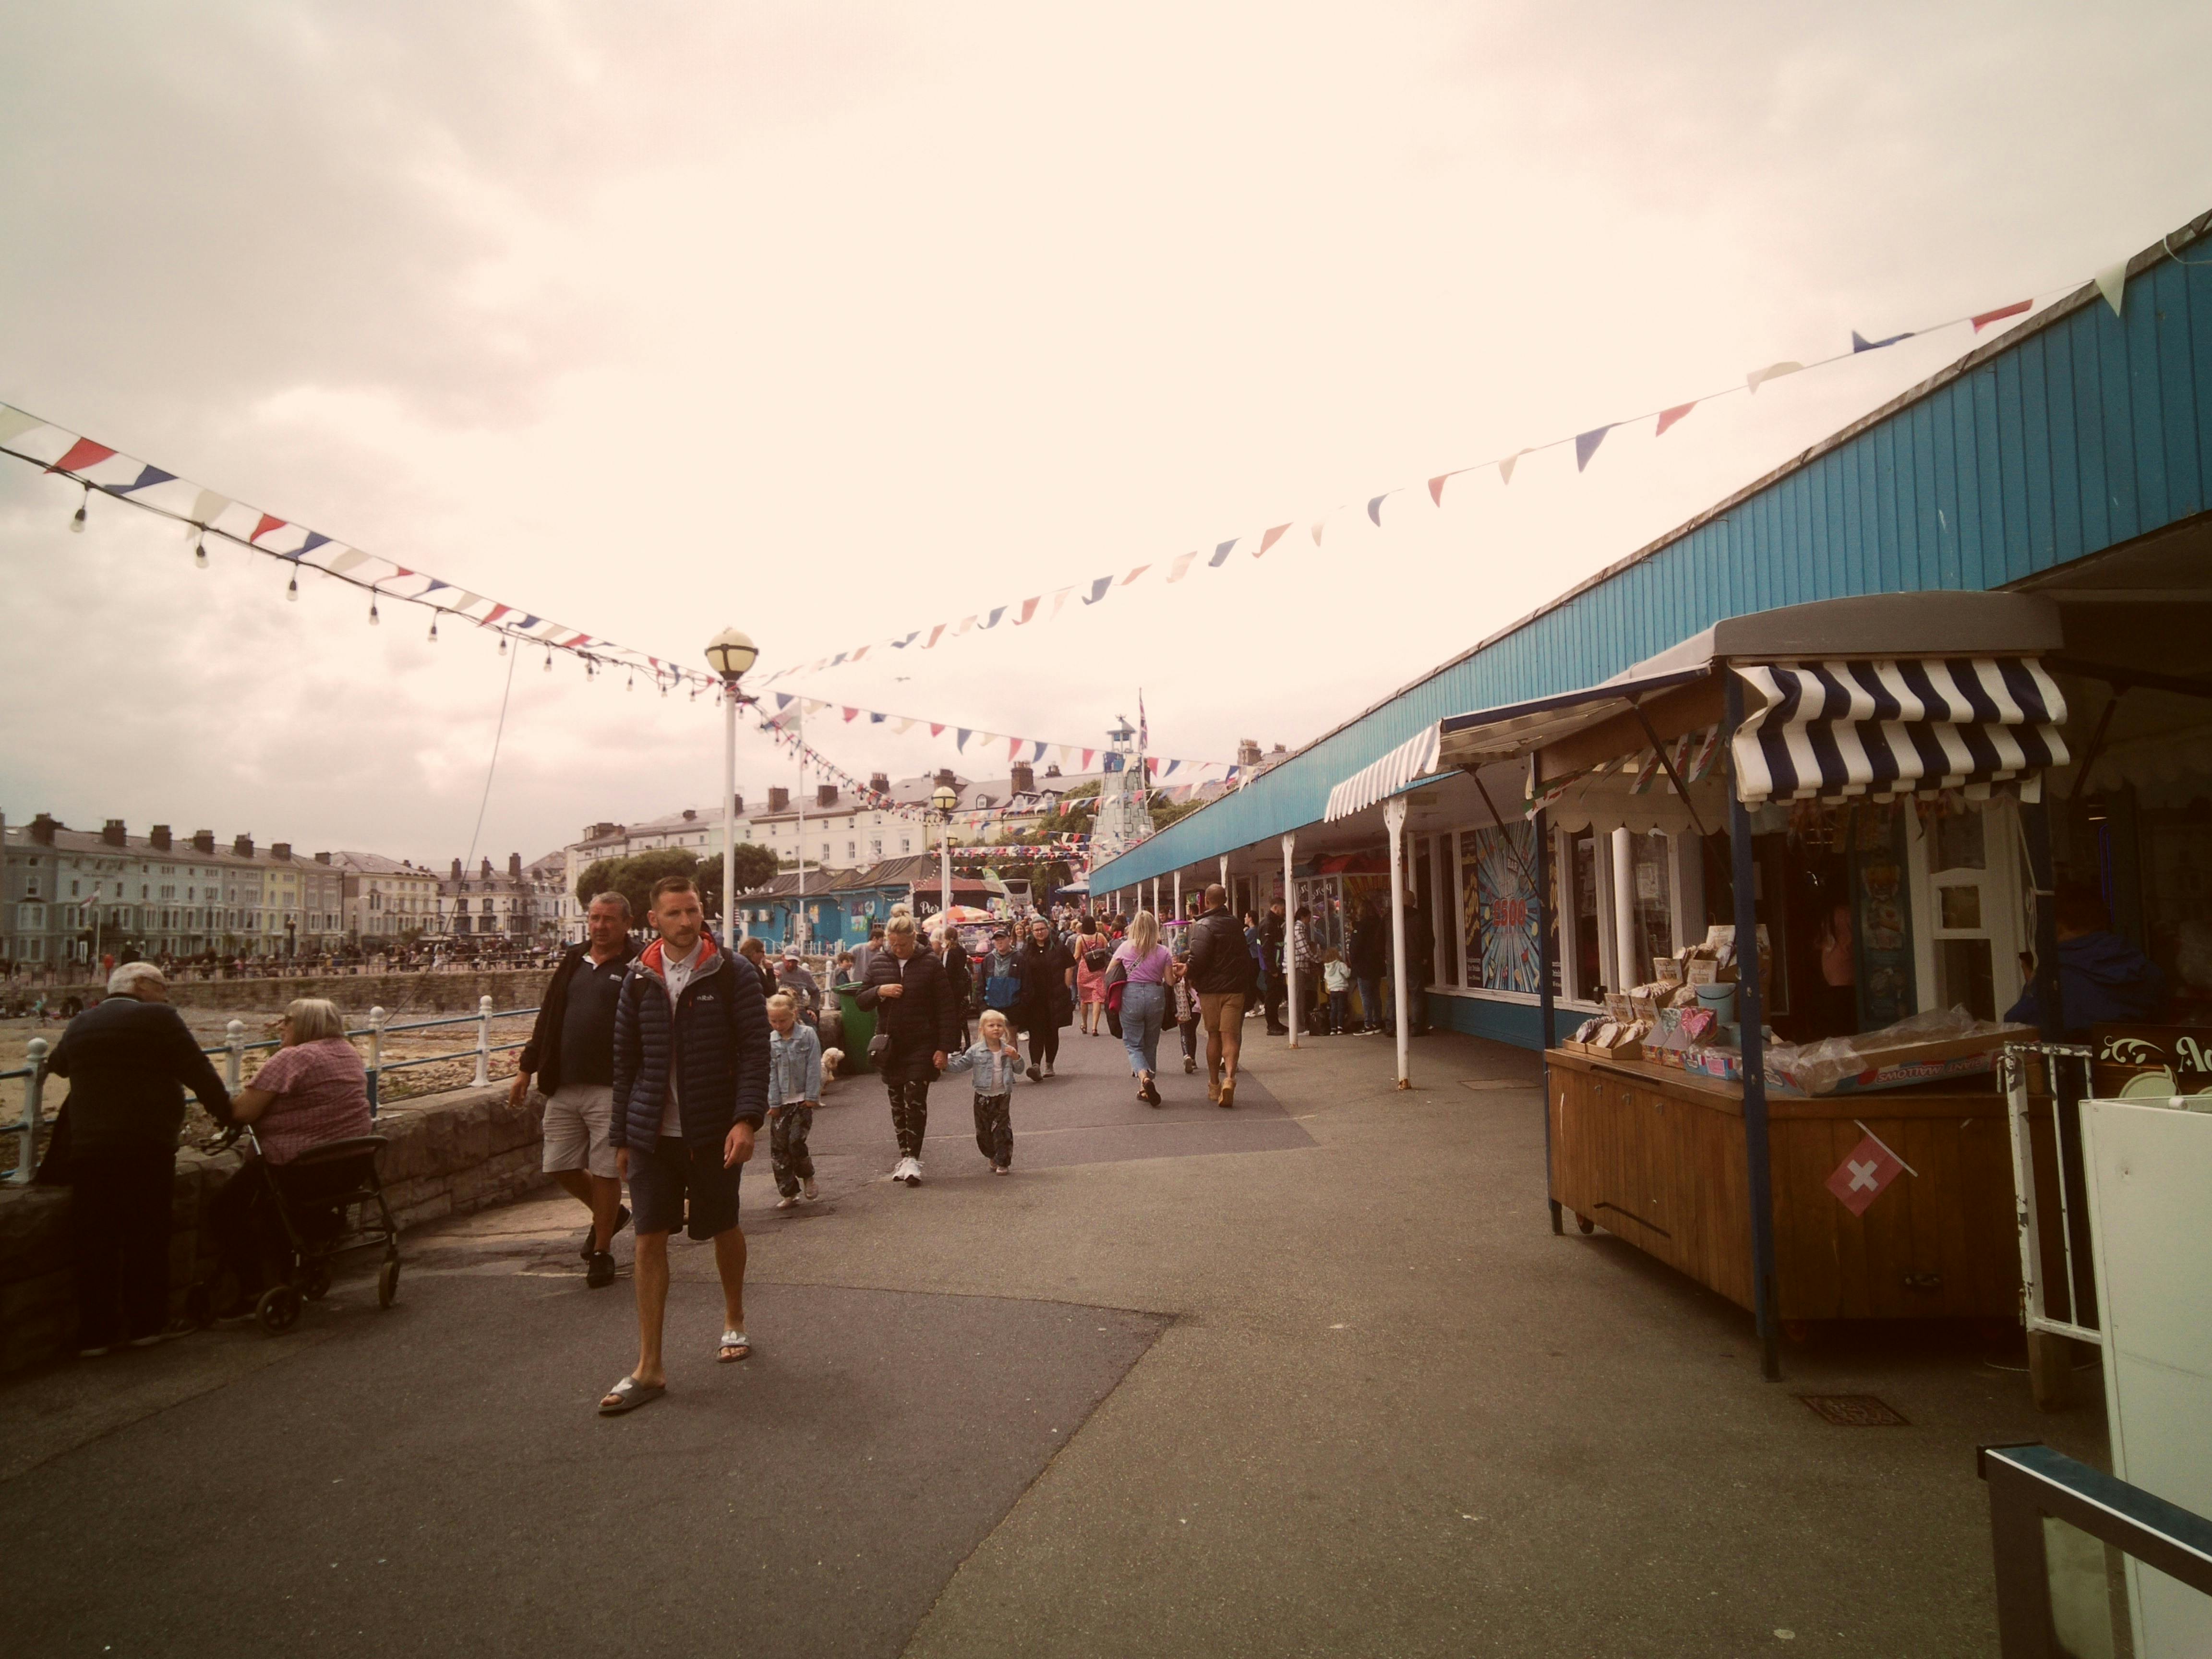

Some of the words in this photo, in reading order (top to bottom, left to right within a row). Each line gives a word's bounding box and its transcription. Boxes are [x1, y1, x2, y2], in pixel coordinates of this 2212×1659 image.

[919, 901, 939, 914] Pier
[1493, 899, 1526, 927] £500
[1876, 1064, 1944, 1082] MALLOWS
[1947, 1056, 1984, 1073] GIANT
